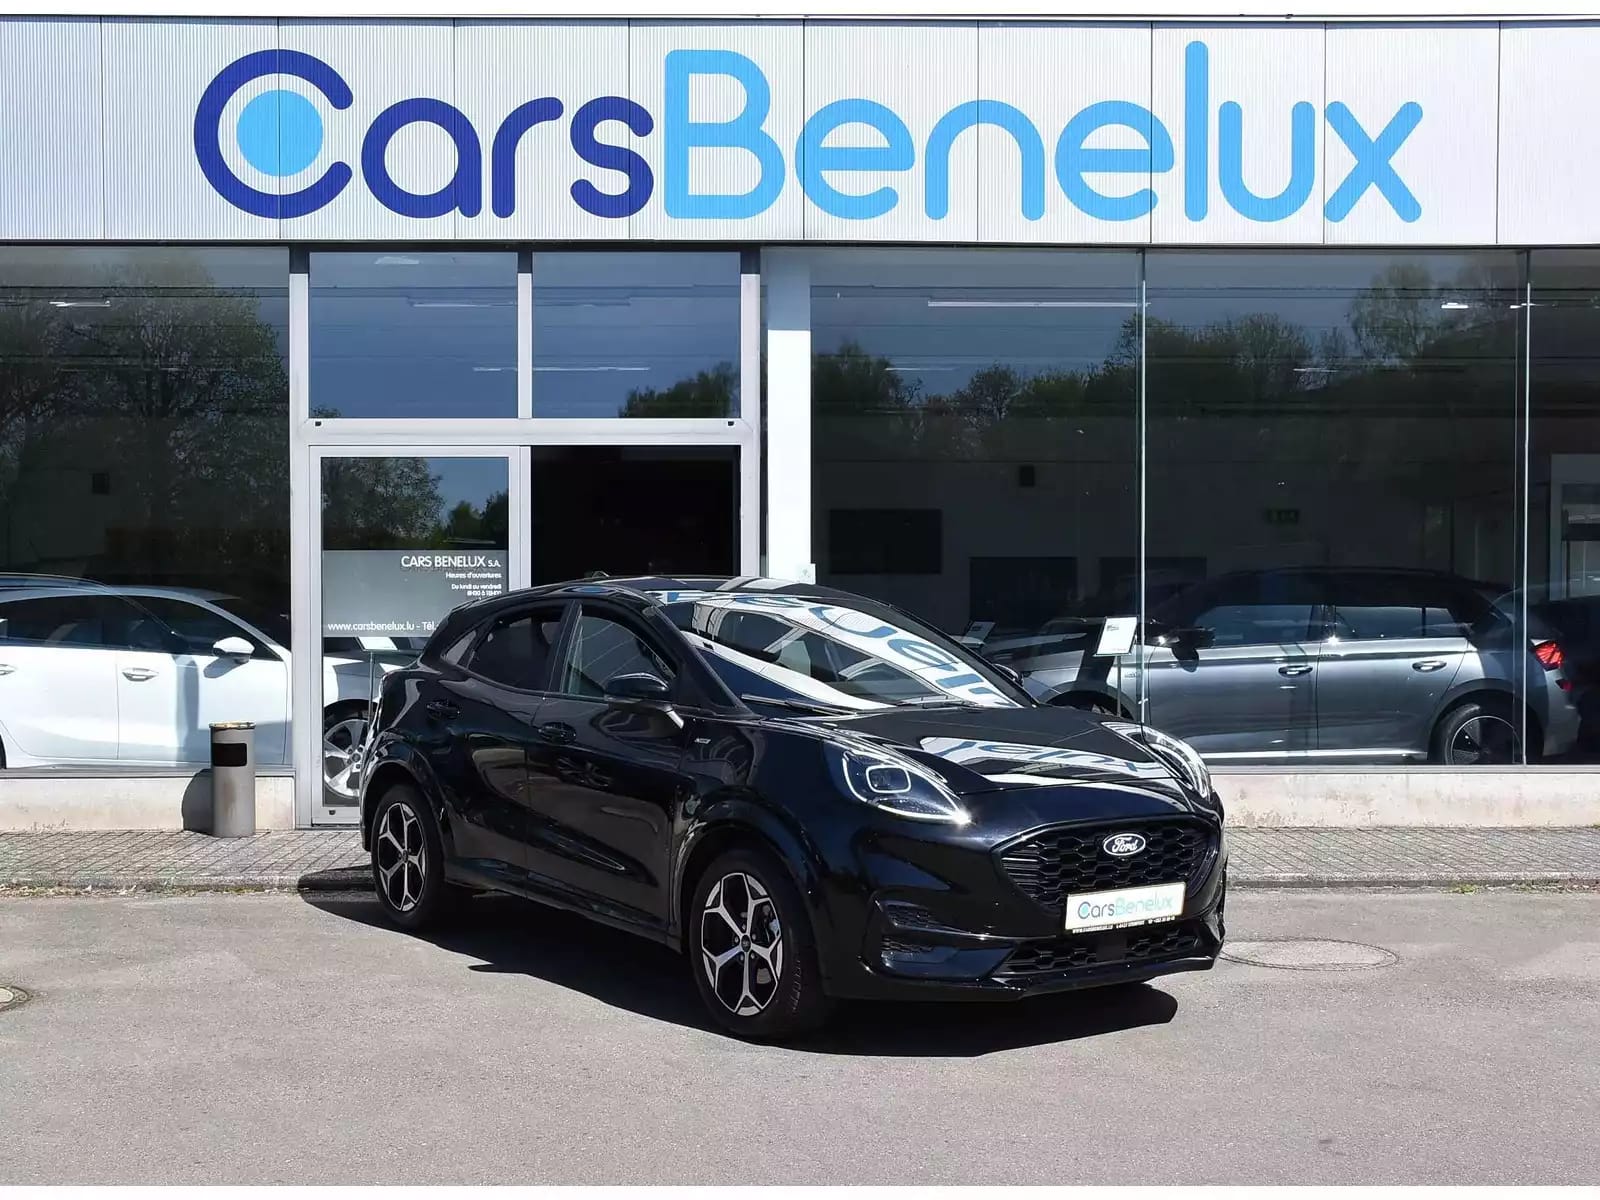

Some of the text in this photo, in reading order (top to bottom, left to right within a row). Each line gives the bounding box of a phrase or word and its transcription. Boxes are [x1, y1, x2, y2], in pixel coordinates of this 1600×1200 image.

[193, 40, 1424, 223] CarsBenelux
[401, 555, 501, 568] CARS BENELUX S.A.
[445, 571, 466, 579] Heures
[327, 621, 415, 631] www.carsbenelux.lu
[1111, 836, 1138, 853] Ford
[1077, 891, 1174, 920] CarsBenelux
